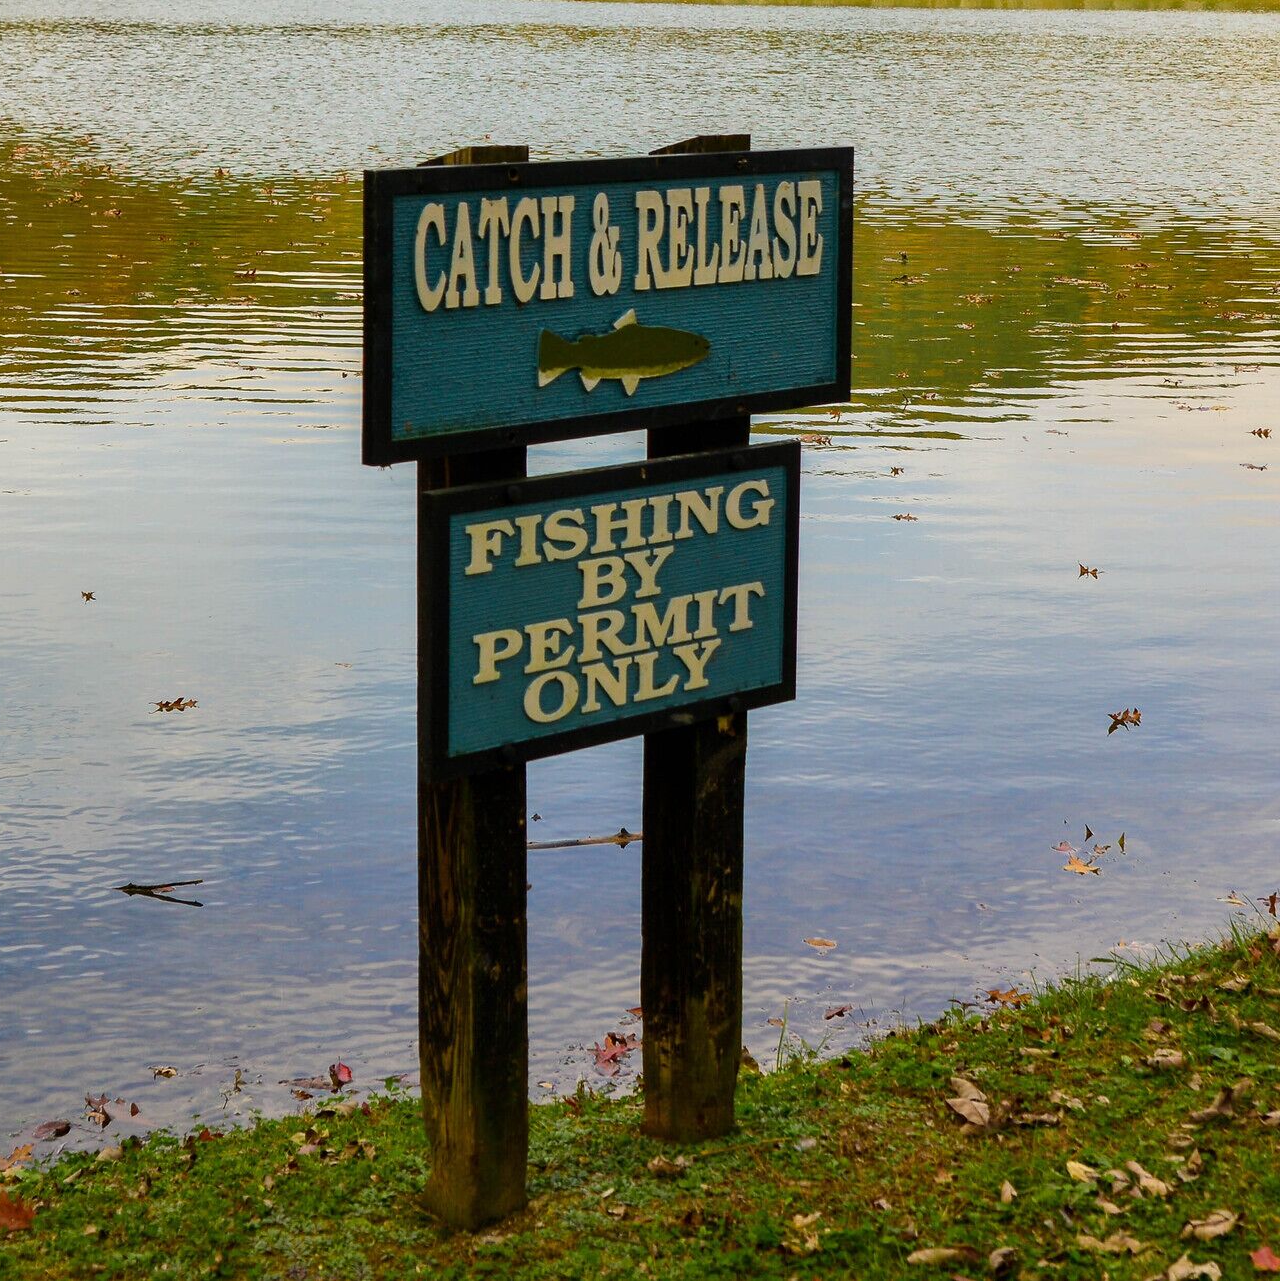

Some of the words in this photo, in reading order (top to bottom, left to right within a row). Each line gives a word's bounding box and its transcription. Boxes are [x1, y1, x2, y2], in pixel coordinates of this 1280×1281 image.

[415, 195, 575, 312] CATCH
[589, 192, 621, 296] &
[634, 180, 823, 291] RELEASE
[465, 479, 775, 576] FISHING
[578, 545, 675, 609] BY
[473, 581, 765, 684] PERMIT
[524, 638, 721, 723] ONLY
